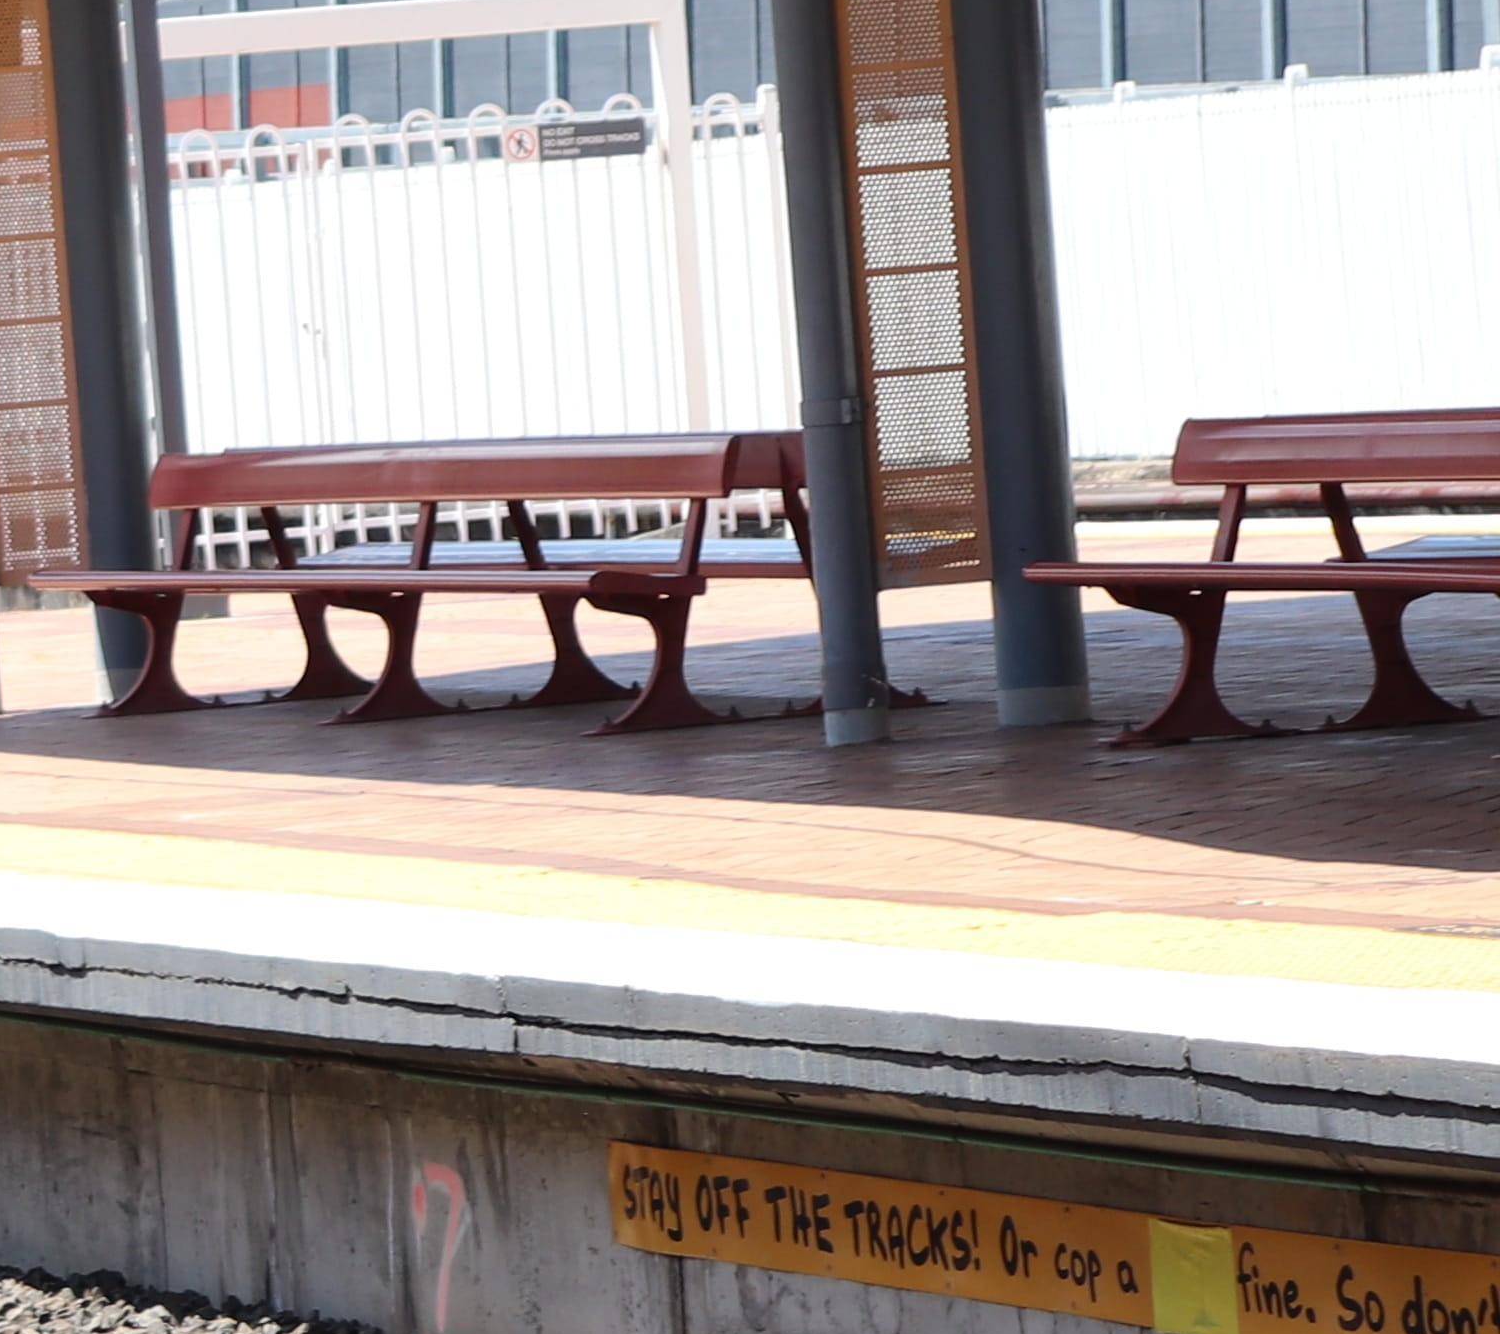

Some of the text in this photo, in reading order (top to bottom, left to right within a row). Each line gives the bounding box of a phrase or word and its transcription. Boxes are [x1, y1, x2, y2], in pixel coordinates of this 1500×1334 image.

[623, 1164, 684, 1243] STAY
[696, 1174, 750, 1239] OFF
[765, 1185, 834, 1254] THE
[843, 1199, 981, 1272] TRACKS!
[1000, 1214, 1039, 1278] Or
[1054, 1242, 1102, 1303] cop
[1117, 1259, 1139, 1295] a
[1236, 1241, 1317, 1324] fine.
[1336, 1264, 1386, 1333] So
